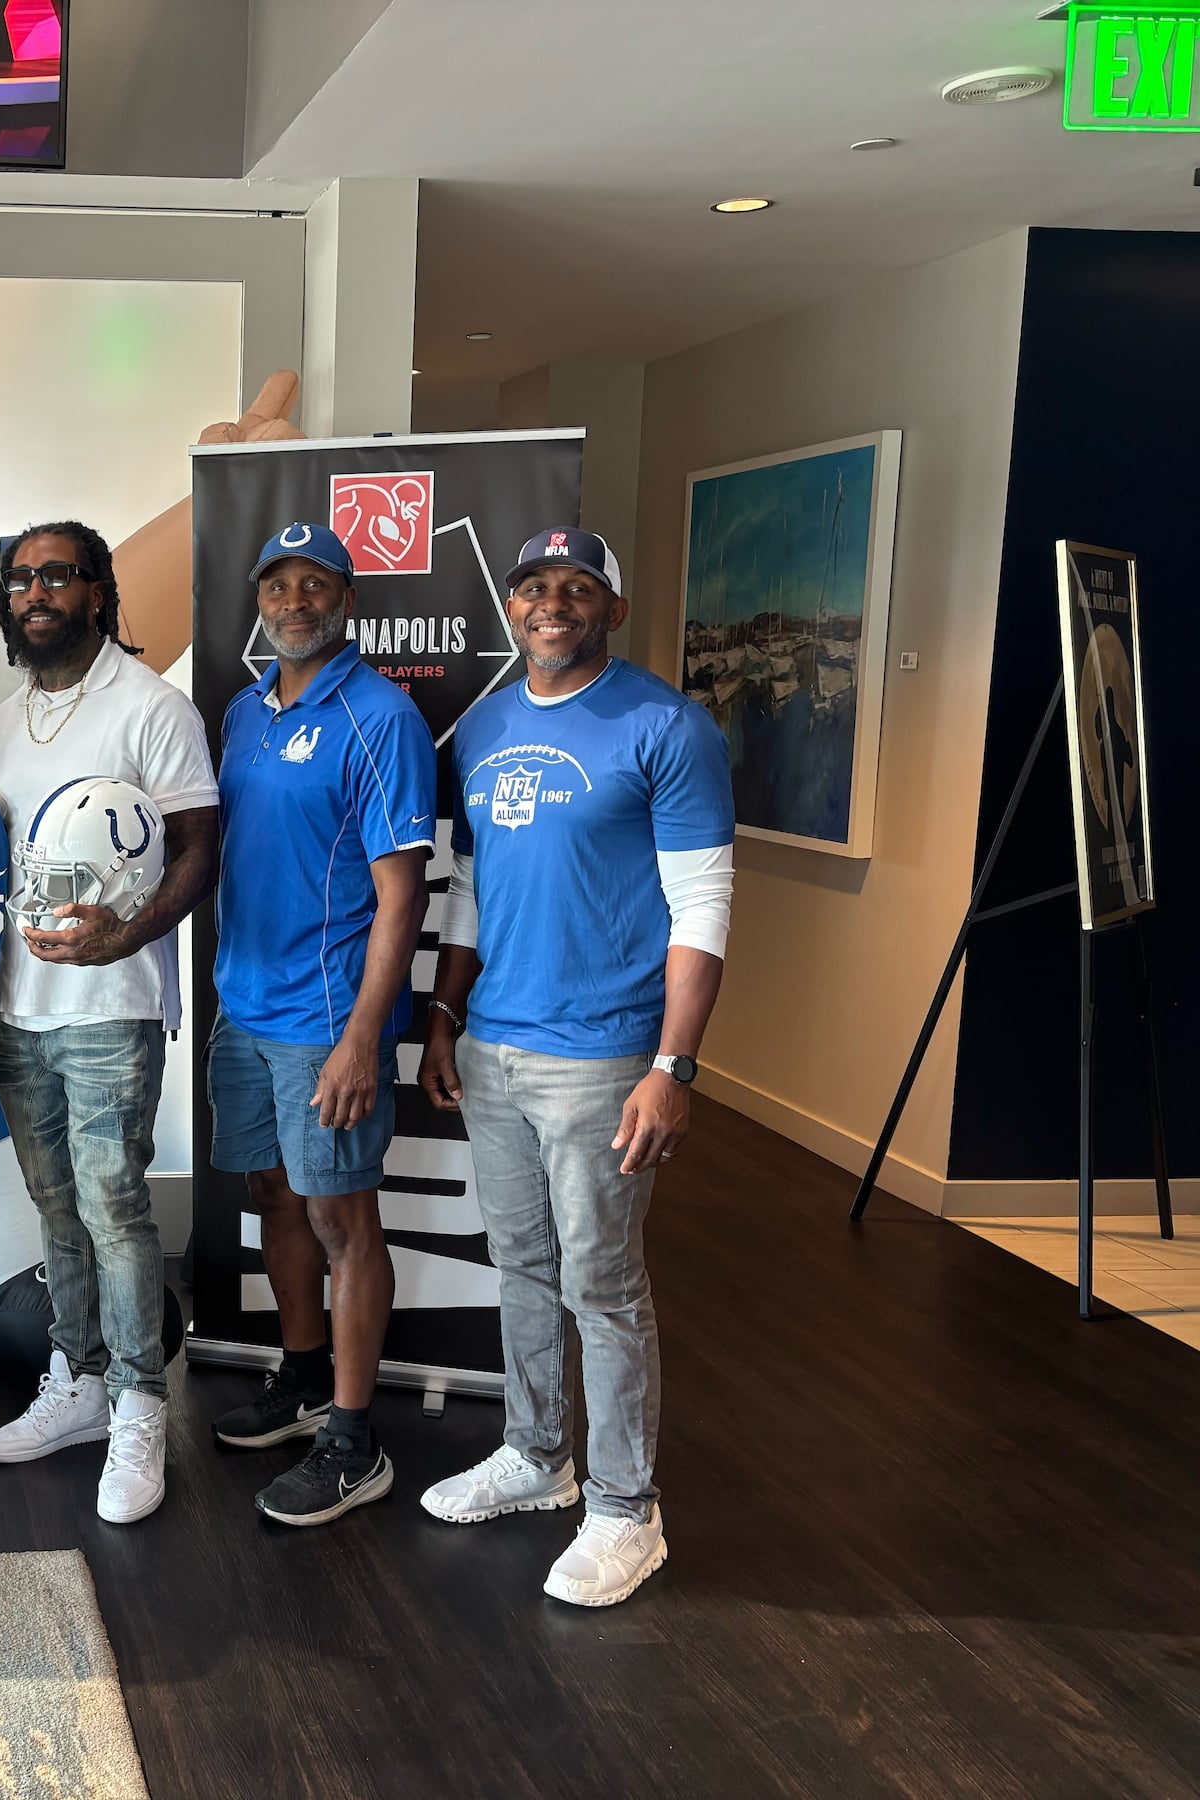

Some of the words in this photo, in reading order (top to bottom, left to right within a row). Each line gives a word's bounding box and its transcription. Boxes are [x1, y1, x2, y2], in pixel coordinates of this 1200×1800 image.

[1093, 16, 1200, 119] EXI
[544, 545, 569, 557] NFLPA
[345, 616, 467, 655] ANAPOLIS
[378, 665, 445, 678] PLAYERS
[496, 776, 534, 800] NFL
[468, 792, 488, 806] EST.
[541, 790, 573, 804] 1967
[495, 809, 530, 821] ALUMNI
